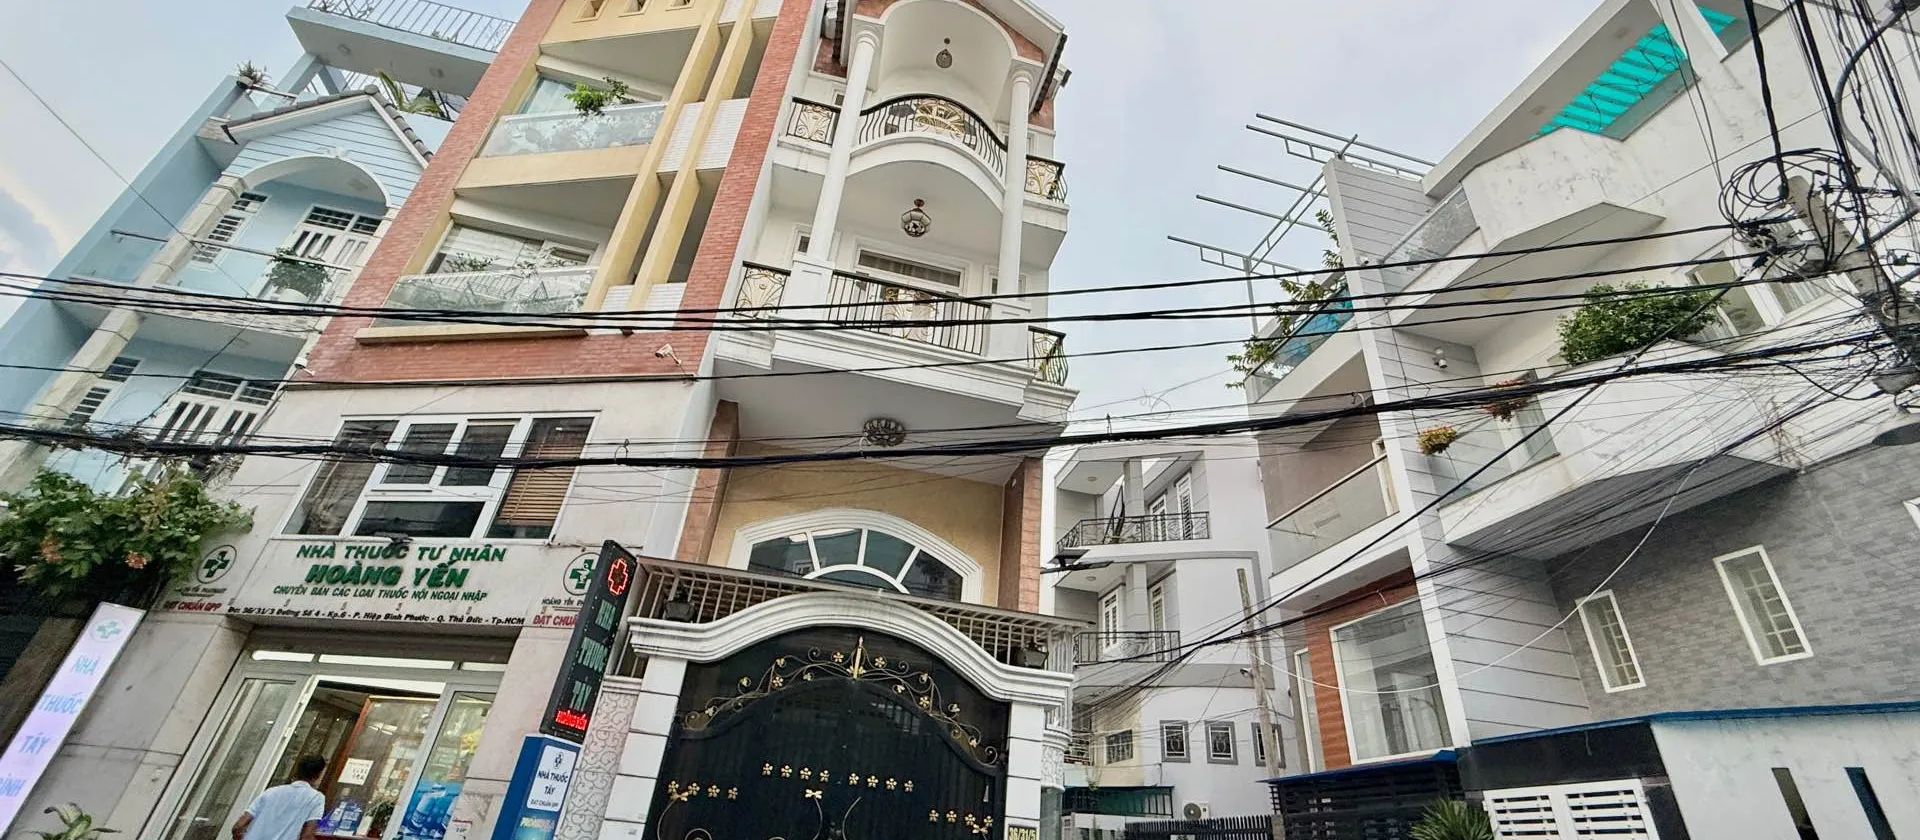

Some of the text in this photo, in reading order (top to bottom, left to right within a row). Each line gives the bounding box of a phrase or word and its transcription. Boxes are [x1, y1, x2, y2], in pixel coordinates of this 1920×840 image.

[296, 541, 336, 558] NHÀ
[418, 545, 447, 560] TƯ
[449, 544, 507, 561] NHÂN
[305, 560, 469, 588] HOÀNG YẾN
[273, 585, 308, 595] CHUYÊN
[311, 585, 329, 596] BÁN
[332, 585, 350, 597] CÁC
[378, 586, 409, 599] THUỐC
[411, 588, 428, 601] NỘI
[430, 590, 459, 602] NGOẠI
[461, 589, 488, 602] NHẬP
